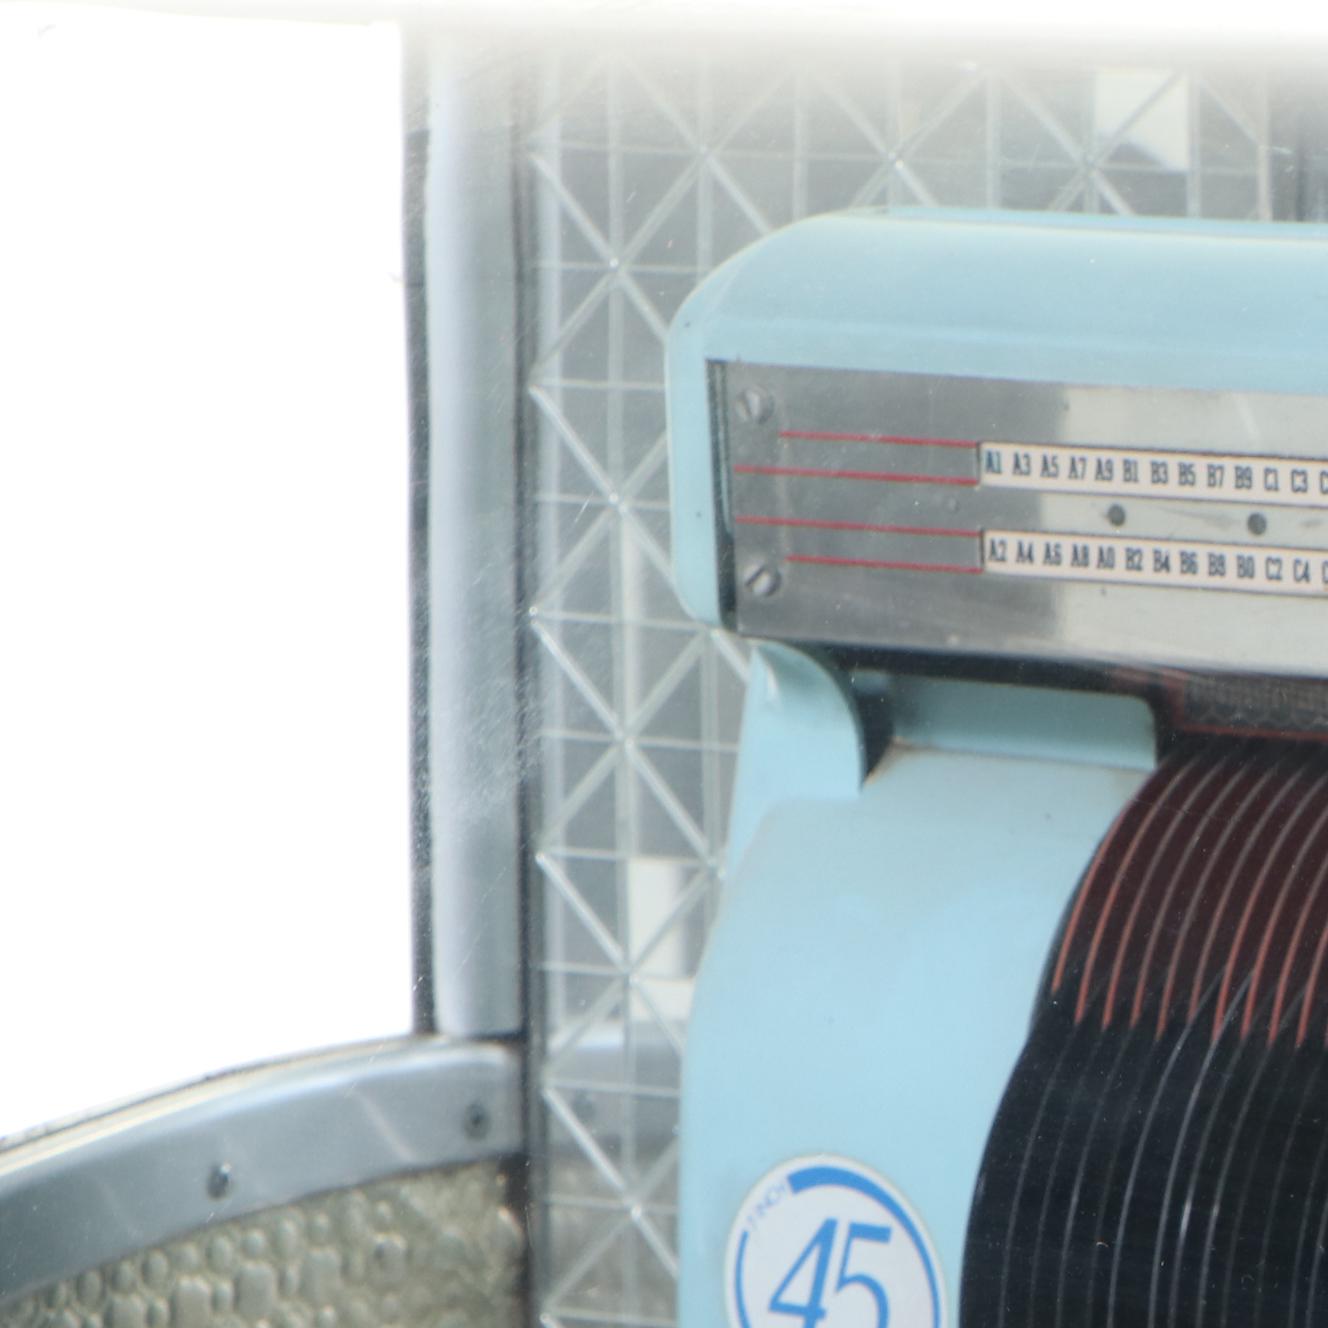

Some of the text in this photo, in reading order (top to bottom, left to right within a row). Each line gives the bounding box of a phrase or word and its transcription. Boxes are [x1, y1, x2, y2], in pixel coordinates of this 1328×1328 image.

[983, 450, 1003, 475] A1
[1012, 453, 1032, 476] A3
[1040, 455, 1060, 479] A5
[1068, 456, 1087, 480] A7
[1094, 458, 1115, 482] A9
[1122, 458, 1139, 484] B1
[1150, 461, 1169, 486] B3
[1177, 462, 1197, 486] B5
[1206, 464, 1225, 488] B7
[1234, 465, 1253, 490] B9
[1263, 467, 1279, 492] C1
[1290, 469, 1309, 495] C3
